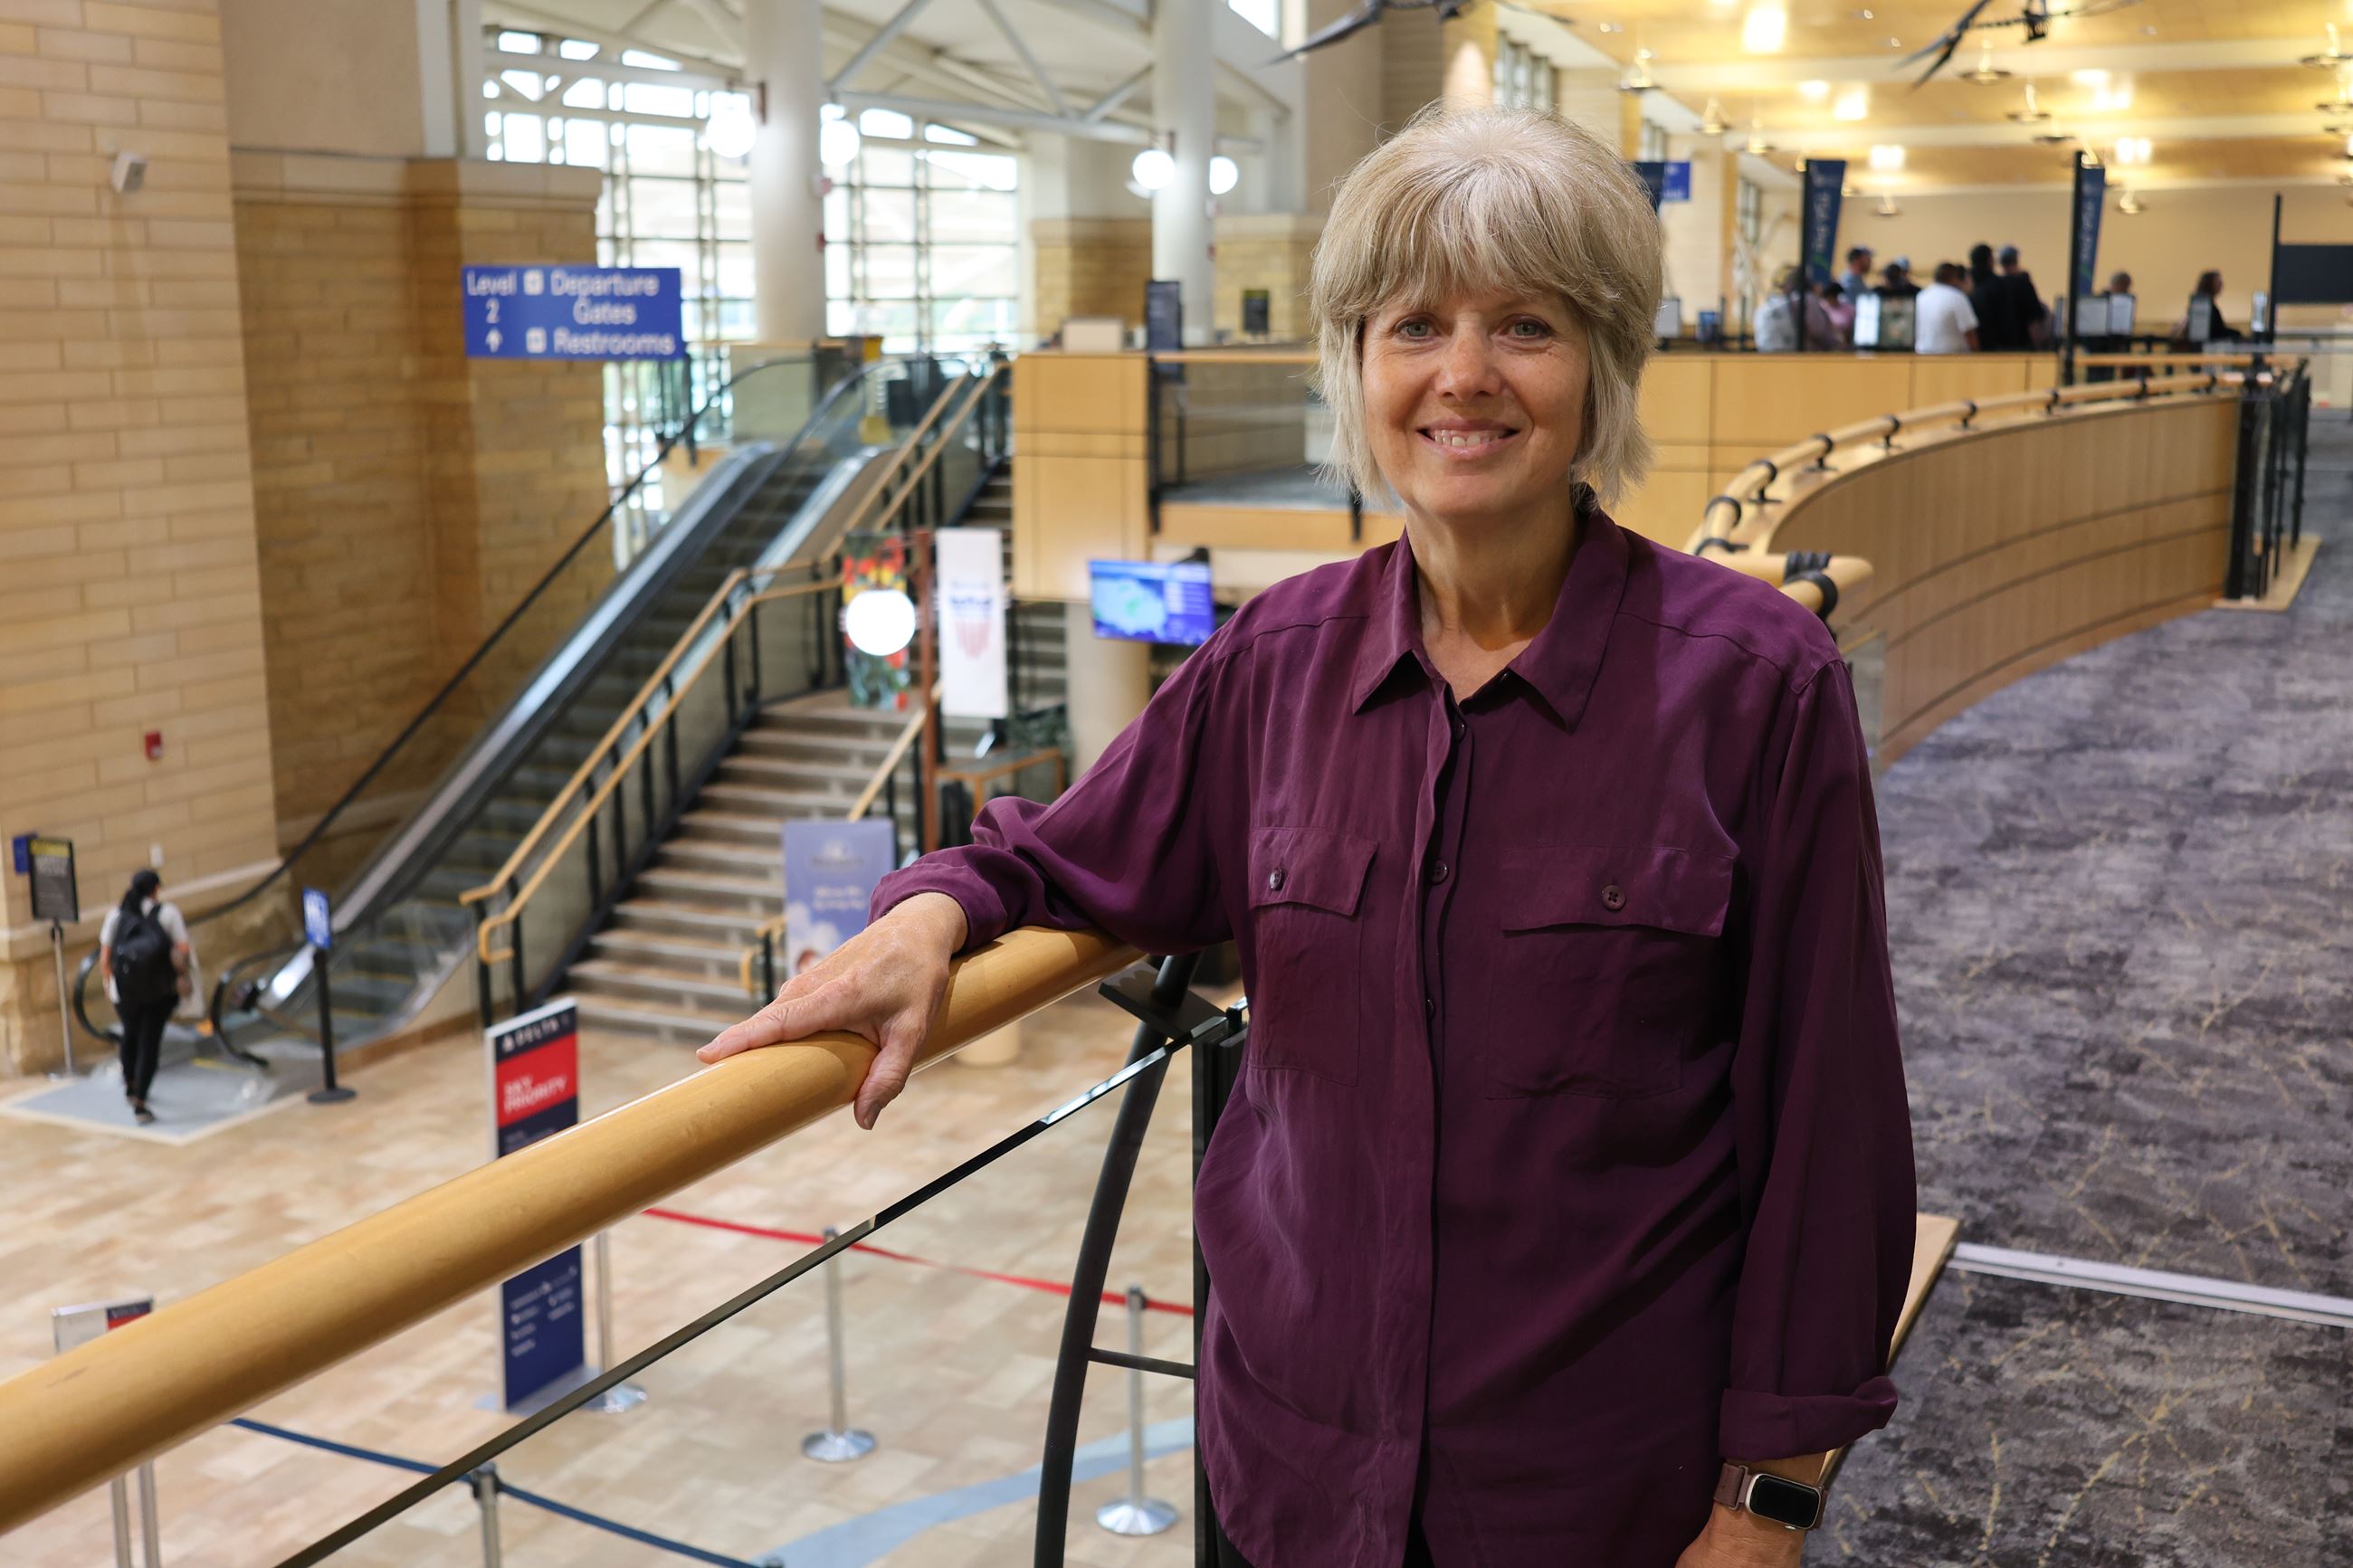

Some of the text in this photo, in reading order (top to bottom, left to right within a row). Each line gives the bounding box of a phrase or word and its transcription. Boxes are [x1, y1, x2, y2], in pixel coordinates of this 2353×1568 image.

[466, 271, 517, 297] Level
[550, 271, 661, 300] Departure
[485, 298, 500, 324] 2
[573, 296, 637, 325] Gates
[553, 327, 675, 355] Restrooms
[515, 1016, 558, 1047] DELTA
